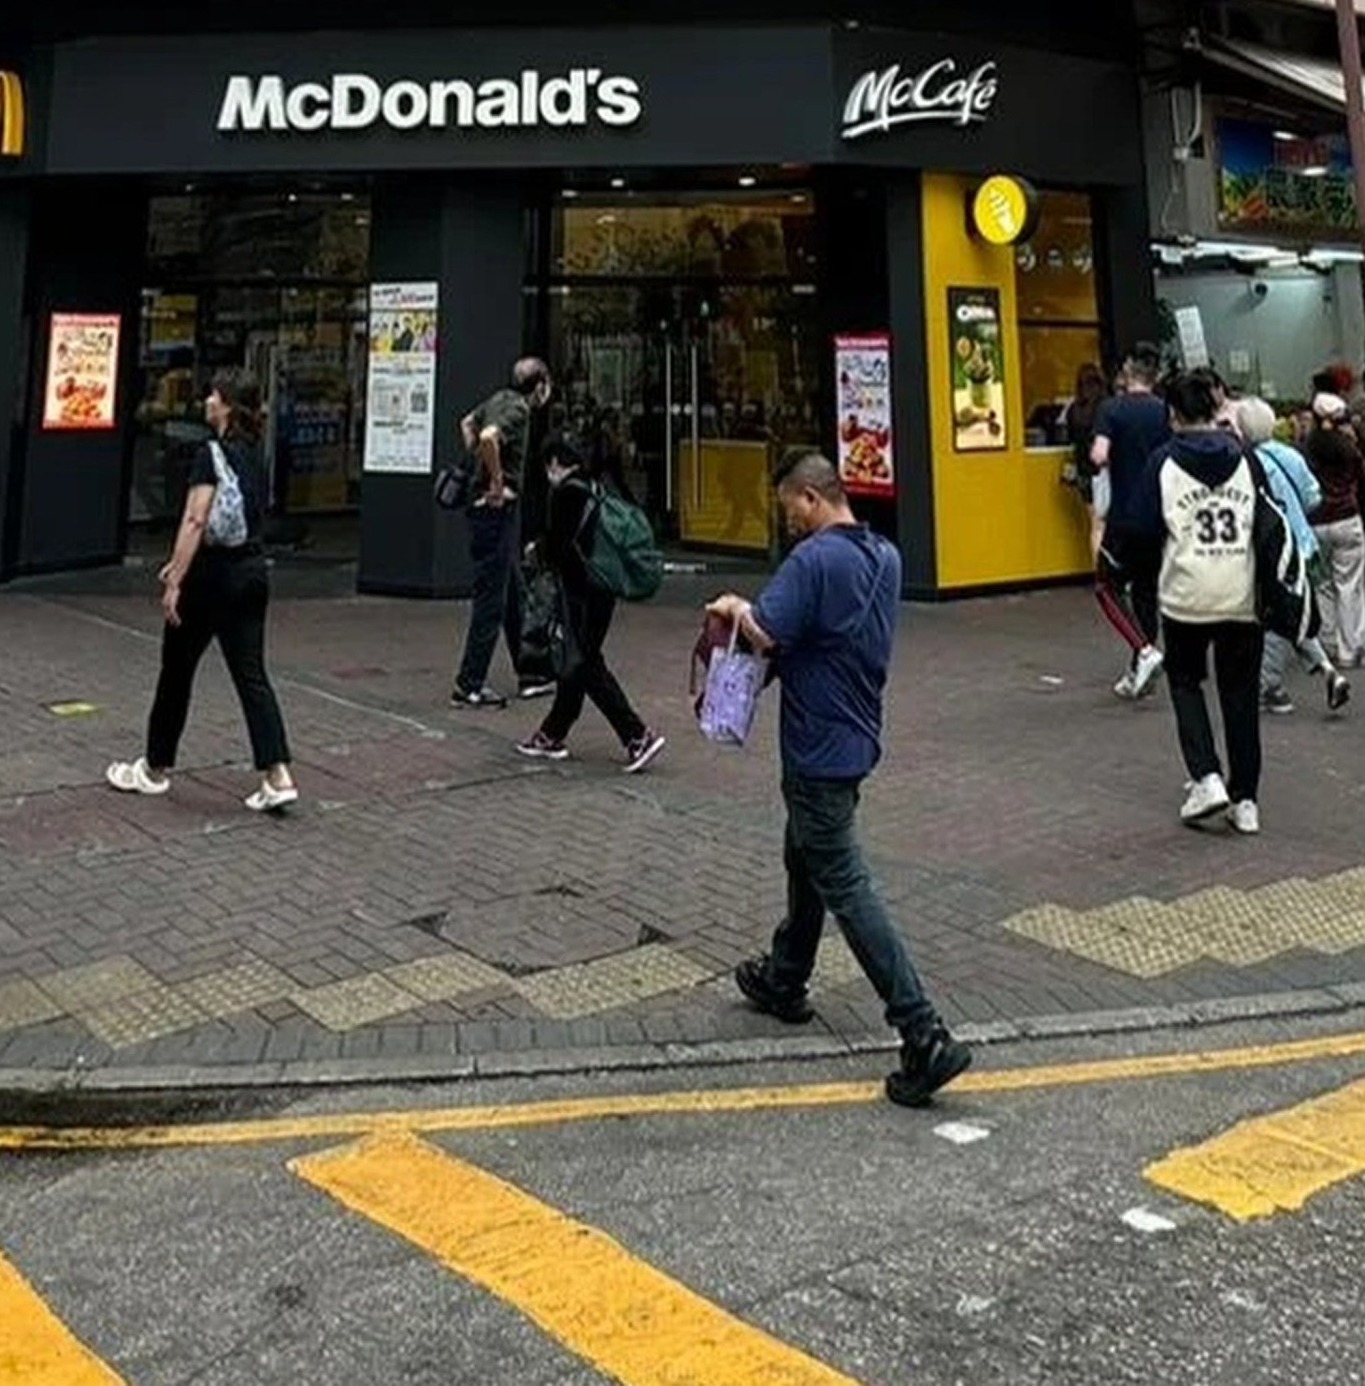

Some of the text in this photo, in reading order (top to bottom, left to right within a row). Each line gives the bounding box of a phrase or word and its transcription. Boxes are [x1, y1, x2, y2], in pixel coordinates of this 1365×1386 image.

[217, 69, 641, 129] McDonald's
[841, 58, 998, 137] McCafé
[1195, 508, 1238, 545] 33
